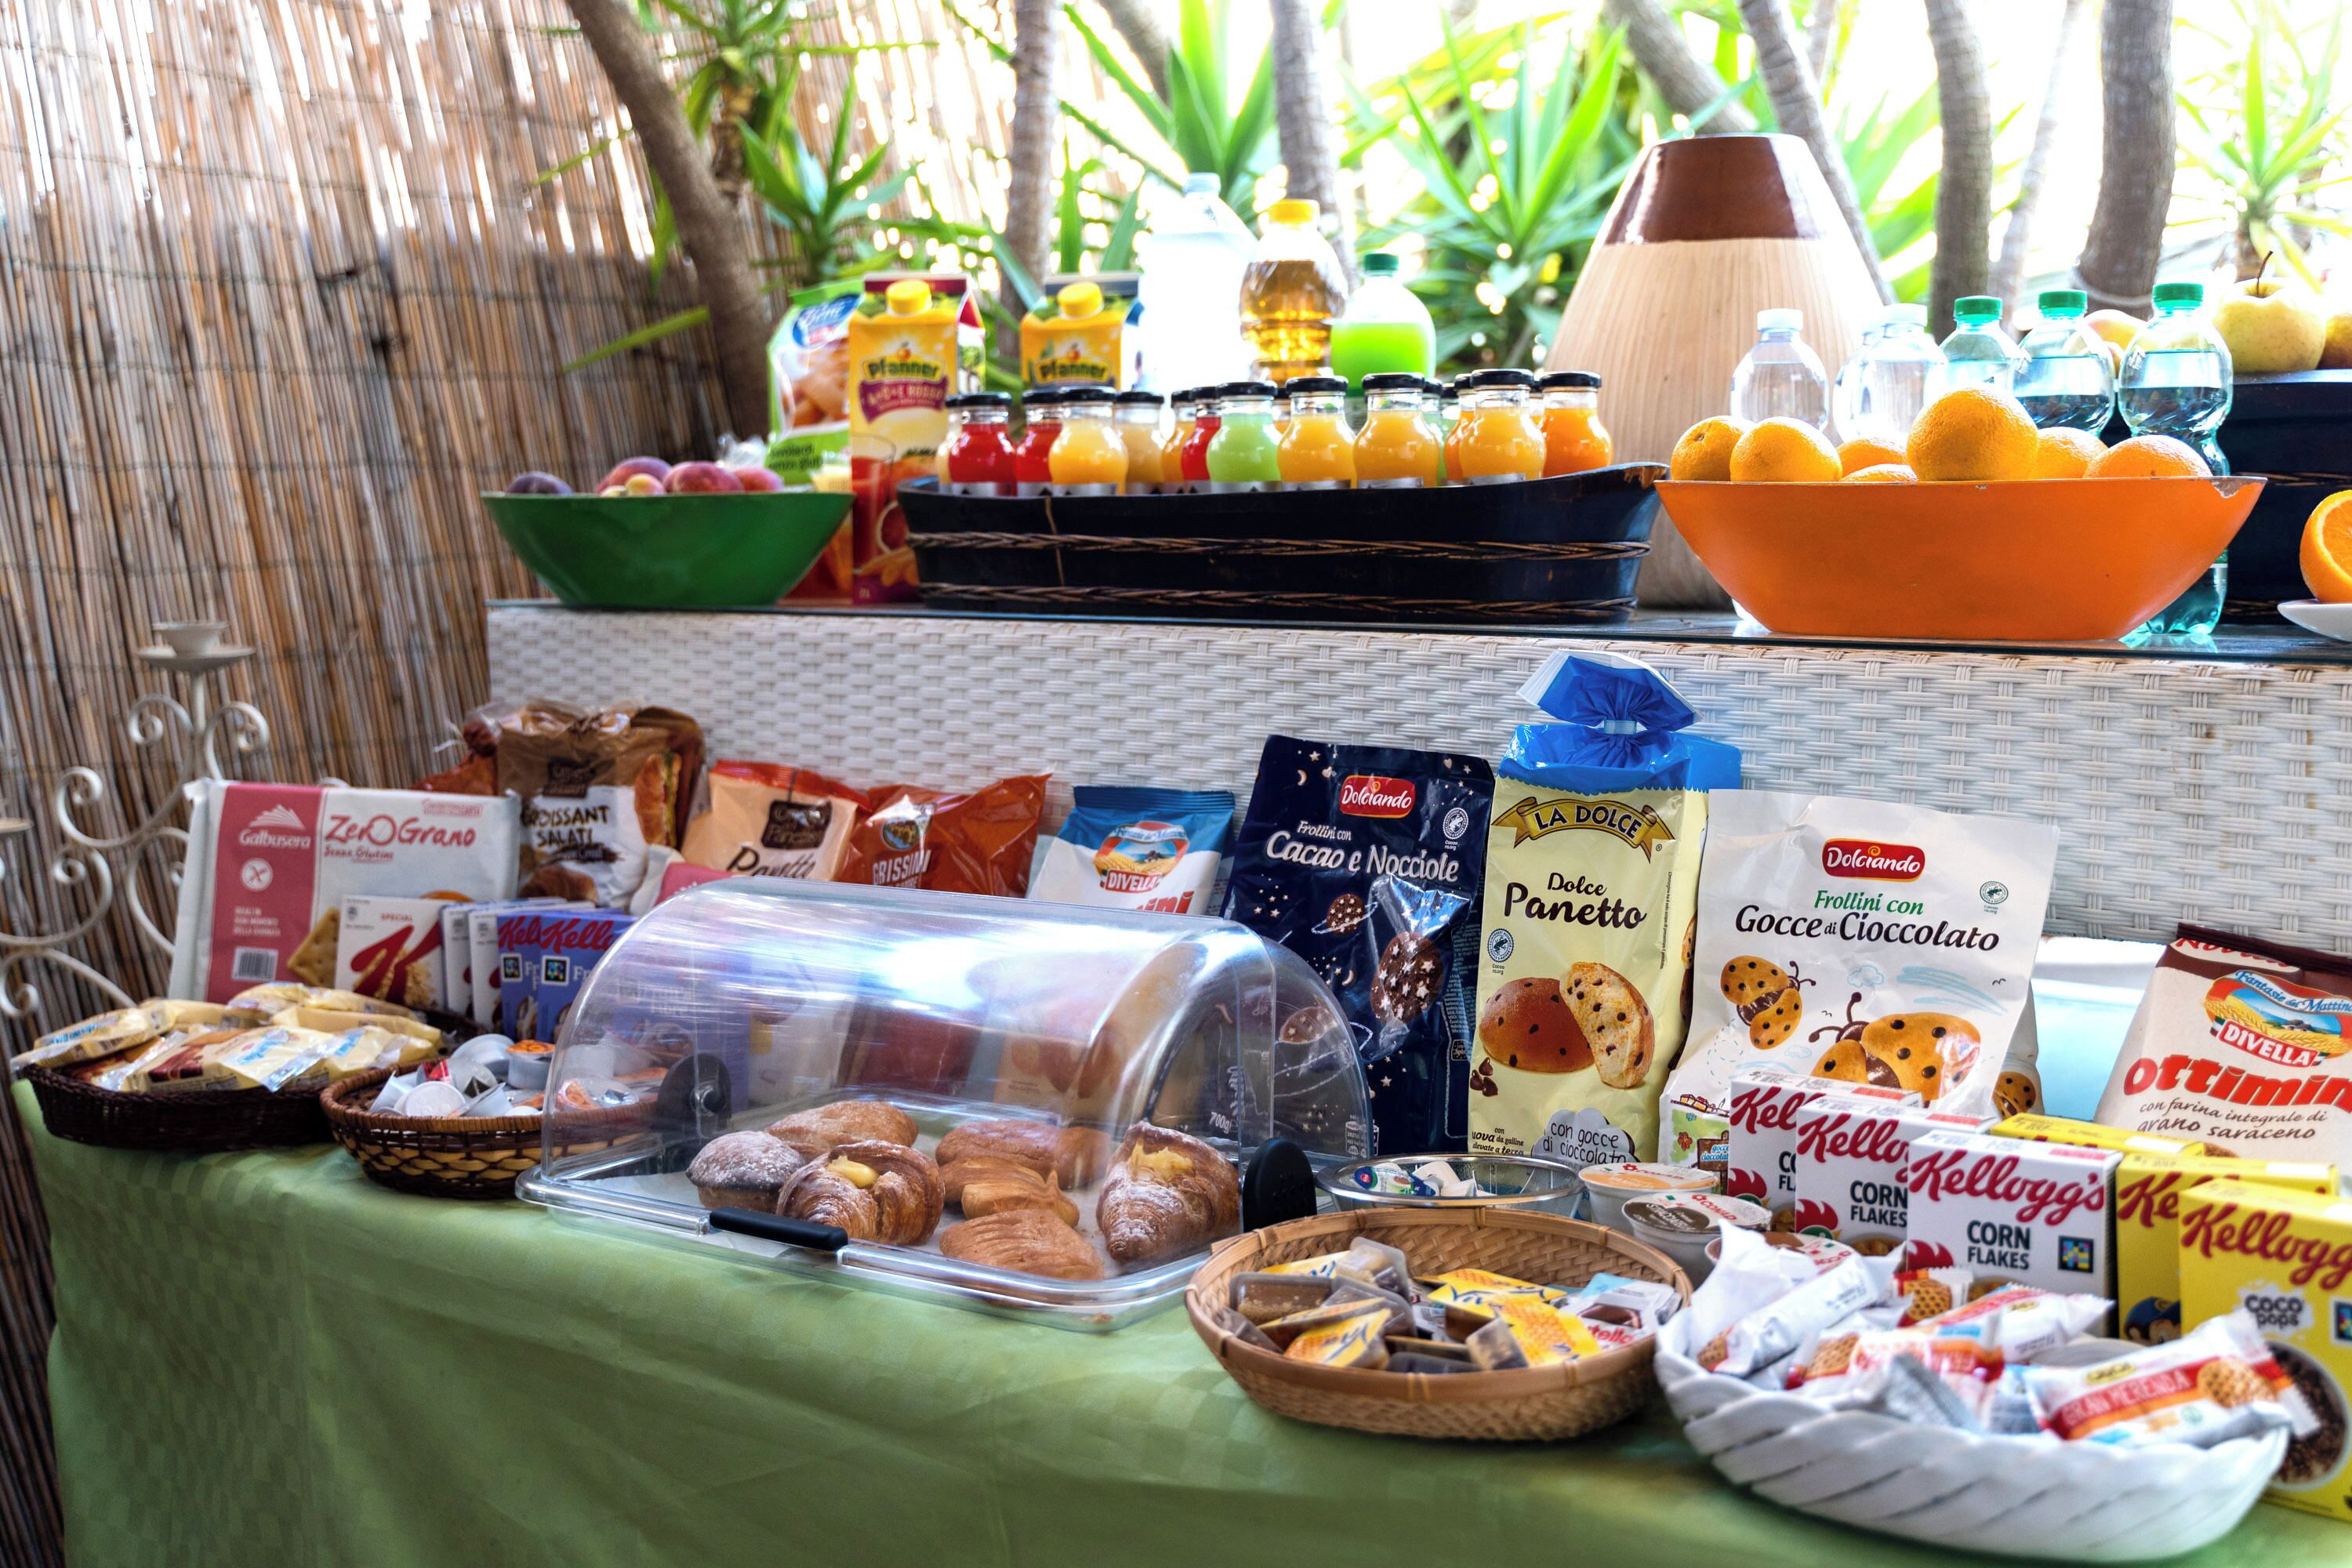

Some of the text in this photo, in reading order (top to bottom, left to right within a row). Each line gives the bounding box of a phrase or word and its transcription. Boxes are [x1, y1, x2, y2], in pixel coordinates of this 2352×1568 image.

[1341, 784, 1412, 809] Dolciando
[1298, 819, 1352, 841] Frollini con
[1534, 805, 1642, 840] LA DOLCE
[239, 828, 310, 850] Galbusera
[1266, 830, 1459, 882] Cacao e Nocciole
[1827, 846, 1921, 874] Dolciando
[1548, 872, 1607, 896] Dolce
[1504, 881, 1647, 930] Panetto
[1814, 890, 1924, 916] Frollini con
[380, 913, 413, 922] SPECIAL
[1735, 904, 2000, 952] Gocce di Cioccolato
[2235, 971, 2286, 1002] Fantasie
[2223, 1023, 2310, 1066] DIVELLA
[2140, 1098, 2327, 1127] con farina integrale di
[1551, 1122, 1619, 1148] con gocce
[2137, 1116, 2316, 1140] grano saraceno
[1504, 1137, 1524, 1146] galline
[1543, 1136, 1553, 1152] di
[1850, 1180, 1908, 1209] CORN
[1907, 1149, 2105, 1226] Kellogg's
[1850, 1205, 1908, 1228] FLAKES
[1967, 1220, 2031, 1250] CORN
[1967, 1246, 2031, 1270] FLAKES
